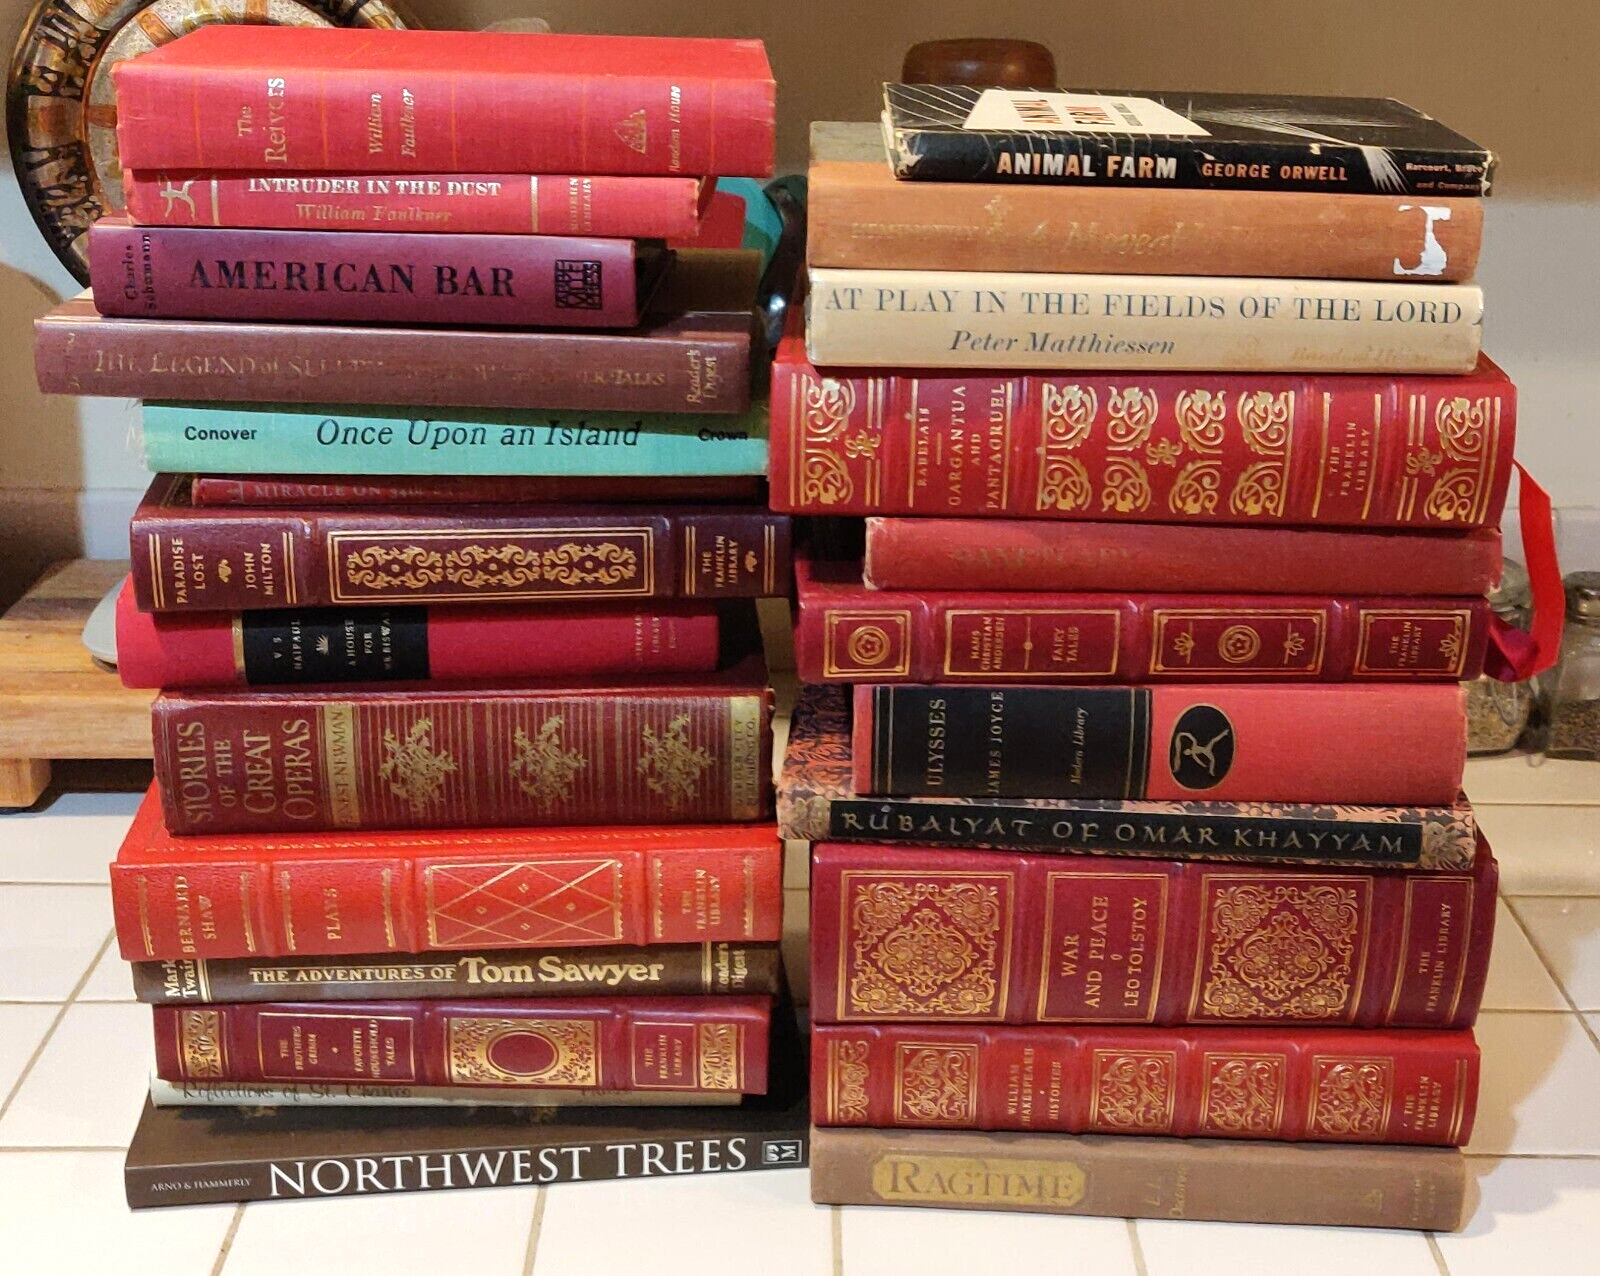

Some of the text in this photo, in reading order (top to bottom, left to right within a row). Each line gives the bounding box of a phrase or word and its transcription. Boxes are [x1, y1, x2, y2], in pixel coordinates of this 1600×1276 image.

[237, 106, 251, 136] The
[368, 92, 382, 154] William
[249, 177, 502, 197] INTRUDER IN THE DUST
[996, 152, 1178, 180] ANIMAL FARM
[1202, 162, 1348, 181] GEORGE ORWELL
[295, 203, 452, 222] William Faulkner
[122, 244, 138, 300] Charles
[141, 234, 157, 310] Schumann
[190, 259, 415, 295] AMERICAN
[433, 264, 518, 298] BAR
[825, 287, 1462, 324] AT PLAY IN THE FIELDS OF THE LORD
[949, 329, 1175, 355] Peter Matthiessen
[184, 425, 258, 441] Conover
[316, 418, 642, 450] Once Upon an Island
[698, 428, 748, 442] Crown
[970, 433, 982, 466] AND
[986, 384, 1006, 509] PANTAGRUEL
[1329, 446, 1340, 473] THE
[1340, 421, 1356, 496] FRANKLIN
[1355, 428, 1371, 492] LIBRARY
[253, 483, 345, 499] MIRACLE
[172, 538, 186, 604] PARADISE
[192, 553, 206, 590] LOST
[244, 552, 257, 589] JOHN
[261, 542, 274, 597] MILTON
[702, 550, 713, 574] THE
[715, 535, 726, 588] FRANKLIN
[728, 539, 739, 584] LIBRARY
[363, 632, 374, 654] FOR
[331, 711, 348, 775] NEWMAN
[926, 698, 947, 786] ULYSSES
[987, 691, 1004, 795] JAMES JOYCE
[1073, 706, 1089, 746] Library
[176, 721, 214, 824] STORIES
[214, 739, 235, 807] OF THE
[243, 729, 277, 814] GREAT
[282, 718, 318, 820] OPERAS
[1052, 821, 1099, 841] OF
[1115, 823, 1219, 847] OMAR
[1234, 827, 1403, 855] KHAYYAM
[174, 875, 195, 953] BERNARD
[198, 895, 218, 940] SHAW
[323, 888, 341, 940] PLAYS
[251, 965, 456, 983] THE ADVENTURES OF
[459, 955, 664, 986] Tom Sawyer
[1061, 934, 1080, 978] WAR
[1084, 895, 1109, 1009] AND PEACE
[1124, 897, 1148, 1009] LEO TOLSTOY
[1007, 1064, 1020, 1115] WILLIAM
[1049, 1060, 1062, 1121] HISTORIES
[150, 1177, 252, 1193] ARNO & HAMMERLY
[268, 1137, 747, 1198] NORTHWEST TREES
[888, 1160, 1074, 1199] RAGTIME
